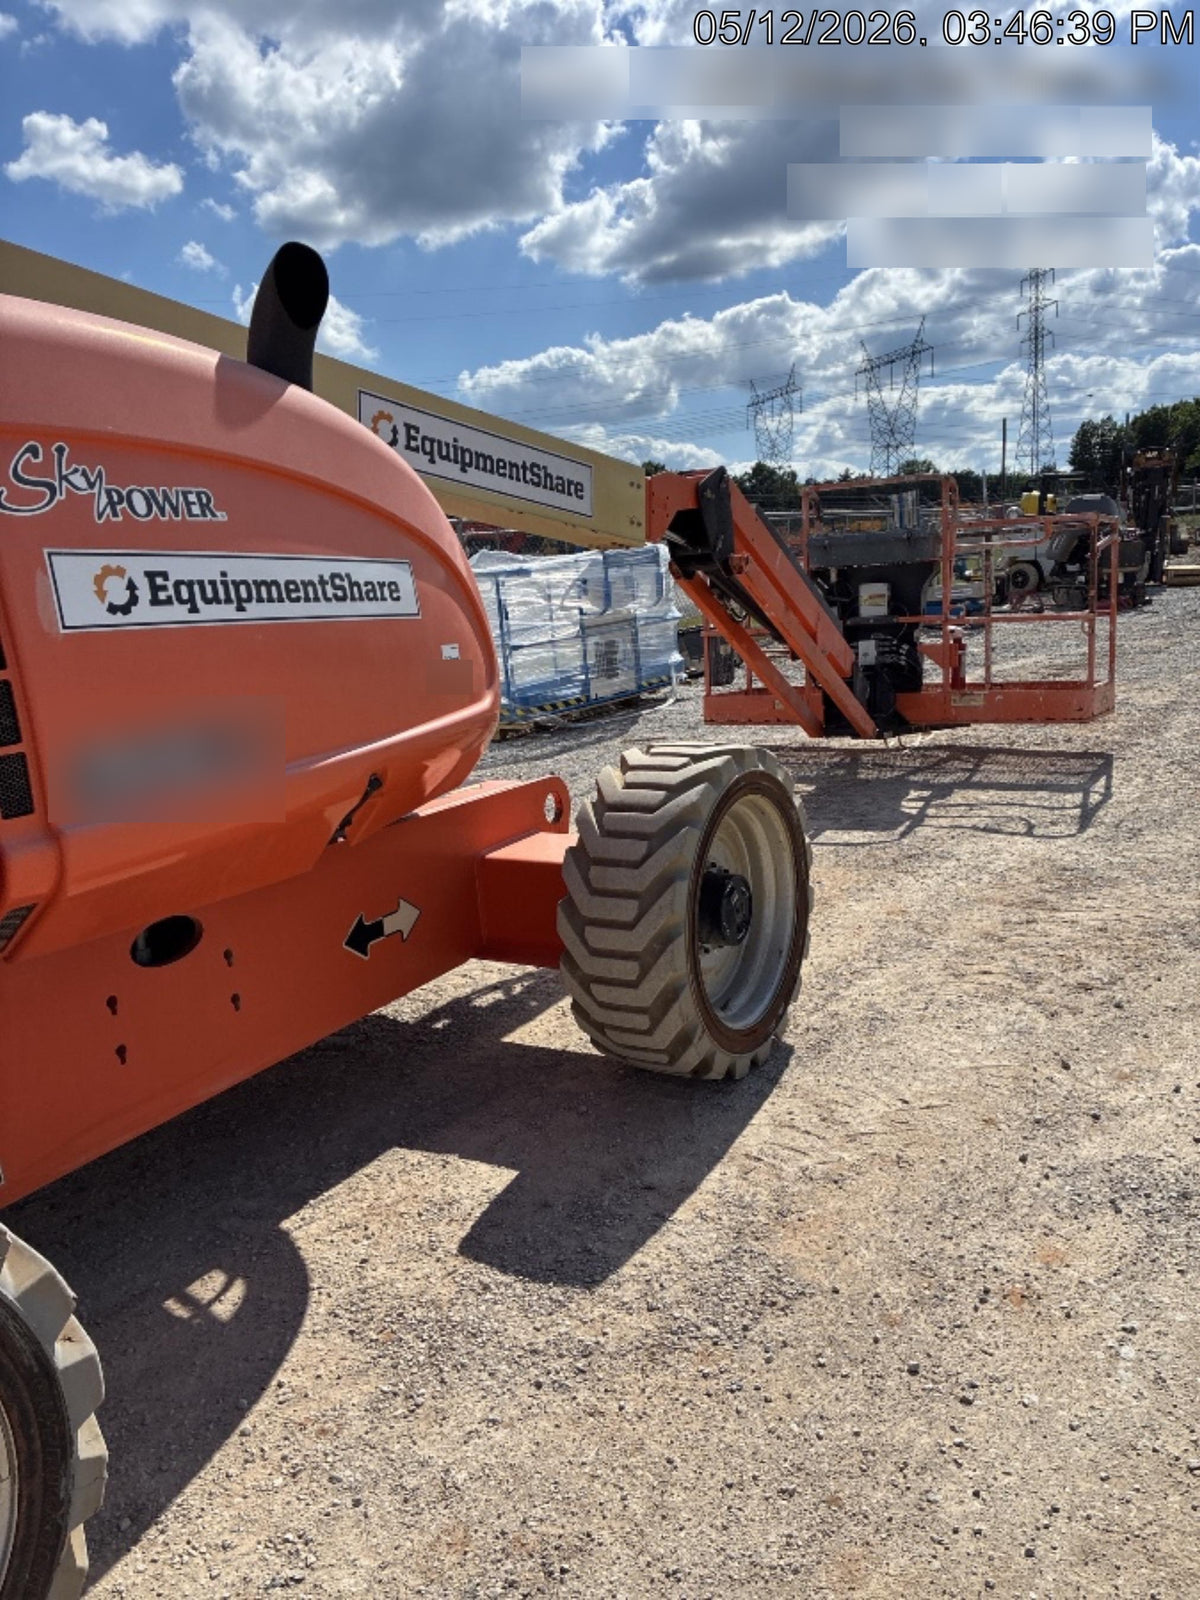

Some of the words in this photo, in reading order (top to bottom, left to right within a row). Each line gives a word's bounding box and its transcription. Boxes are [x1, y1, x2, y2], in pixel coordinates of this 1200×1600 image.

[0, 442, 104, 521] Sky
[403, 421, 584, 500] EquipmentShare
[143, 570, 402, 614] EquipmentShare
